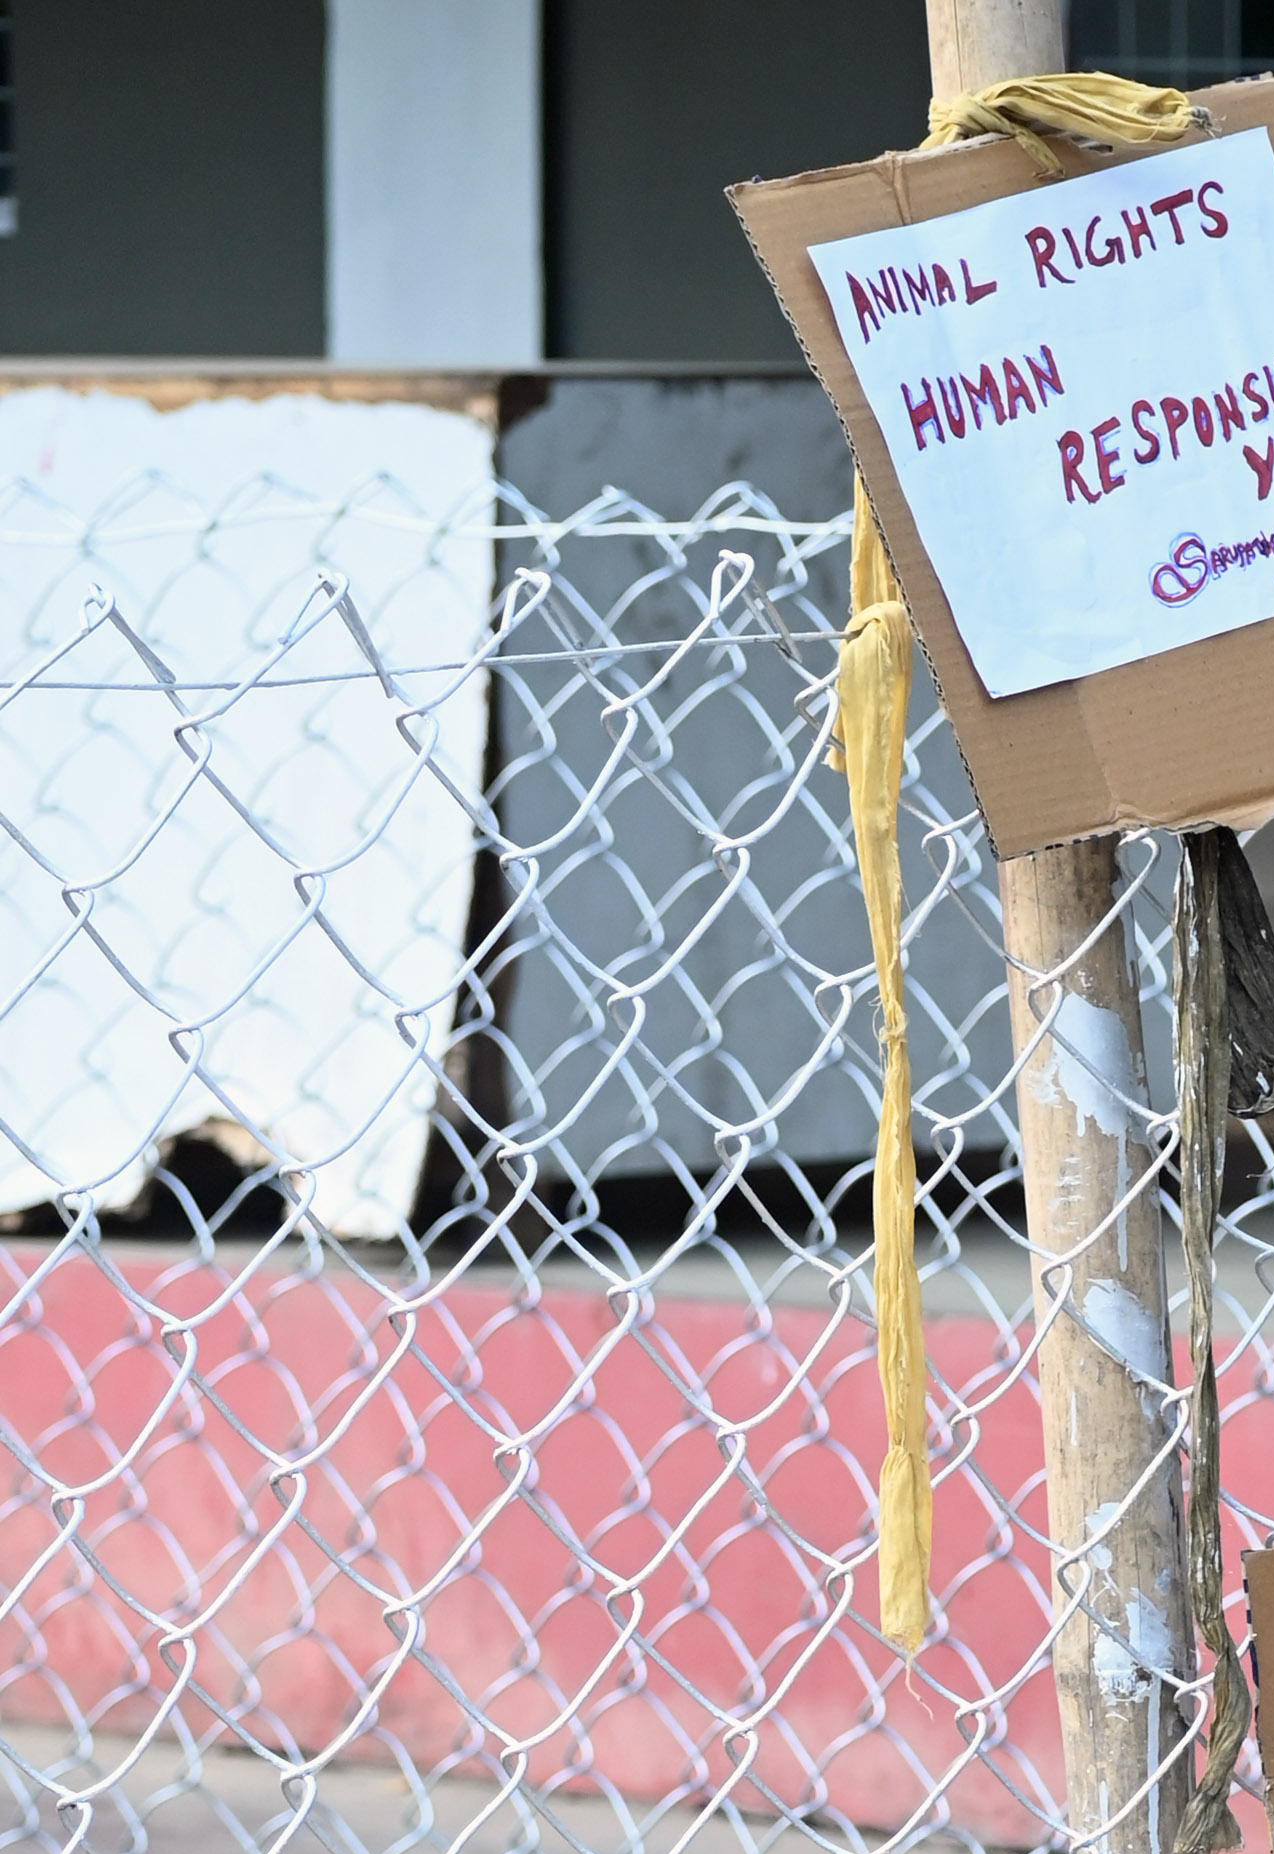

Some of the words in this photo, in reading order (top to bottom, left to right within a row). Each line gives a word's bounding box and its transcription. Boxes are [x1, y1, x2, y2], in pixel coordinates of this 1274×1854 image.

[846, 259, 996, 342] ANIMAL
[1025, 181, 1228, 288] RIGHTS
[900, 345, 1065, 450] HUMAN
